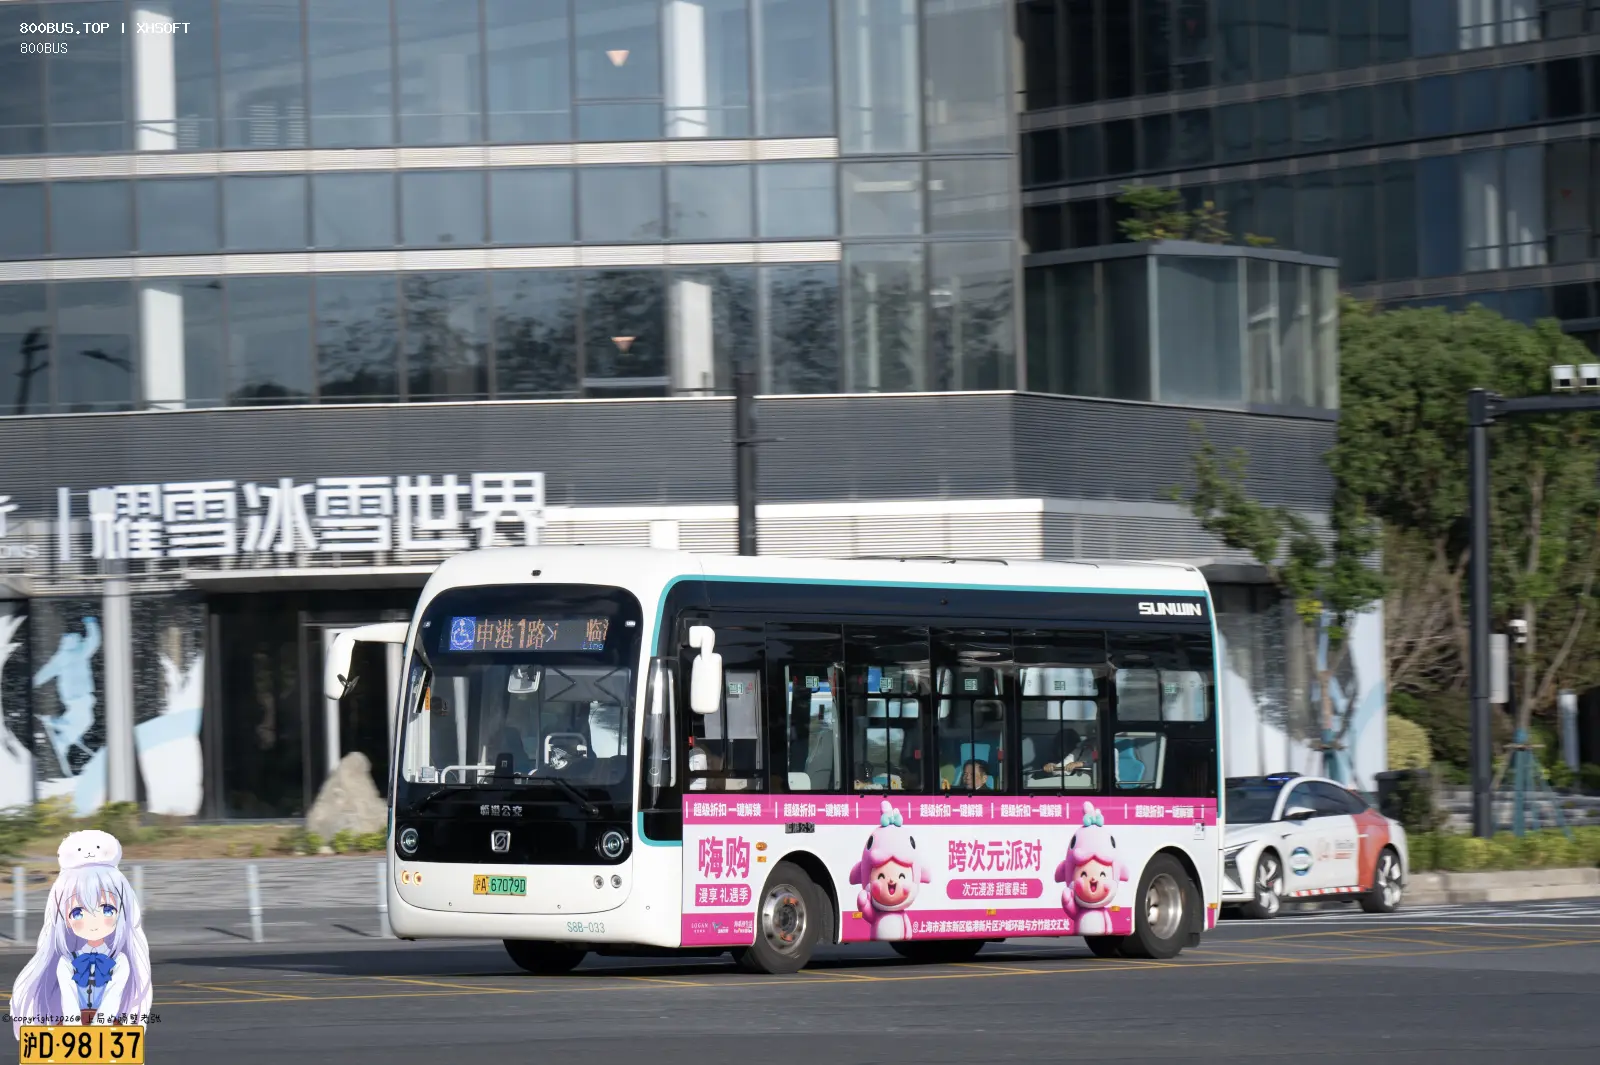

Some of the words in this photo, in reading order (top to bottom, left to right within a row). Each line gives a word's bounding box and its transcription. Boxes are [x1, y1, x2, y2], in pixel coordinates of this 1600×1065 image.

[89, 472, 546, 560] 耀雪冰雪世界
[1138, 602, 1202, 616] SUNWIN
[476, 618, 545, 650] 申港1路
[698, 835, 750, 879] 嗨购
[948, 838, 1042, 872] 跨次元派对
[567, 921, 606, 934] S8B-033
